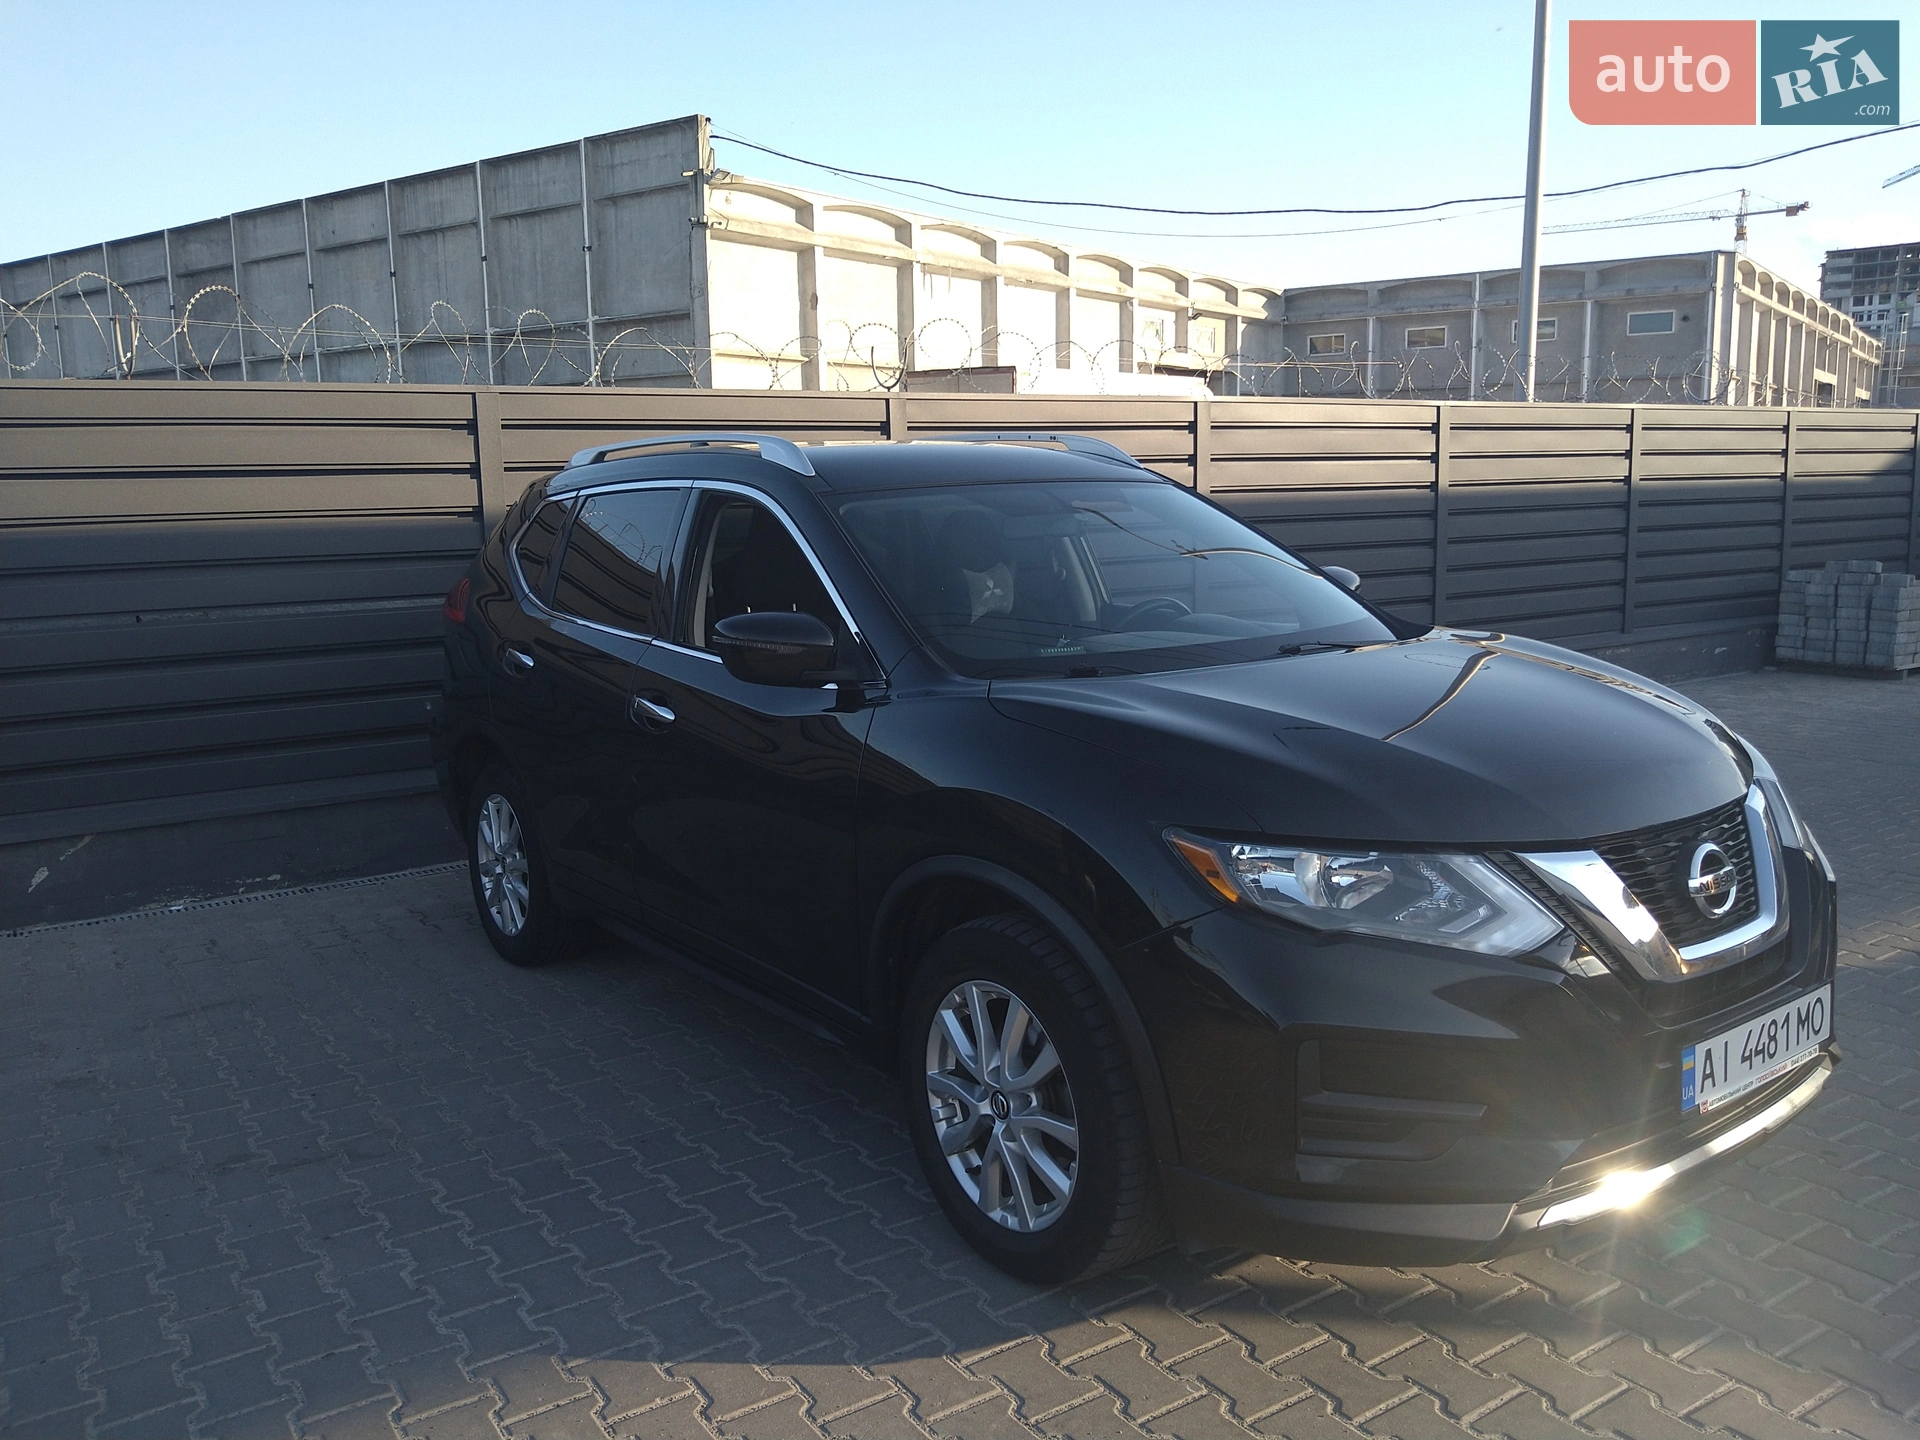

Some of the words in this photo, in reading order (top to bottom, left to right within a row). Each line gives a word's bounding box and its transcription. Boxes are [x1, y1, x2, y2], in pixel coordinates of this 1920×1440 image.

[1700, 1041, 1728, 1094] AI
[1741, 1012, 1790, 1070] 4481
[1796, 997, 1824, 1046] MO
[1682, 1085, 1694, 1101] UA
